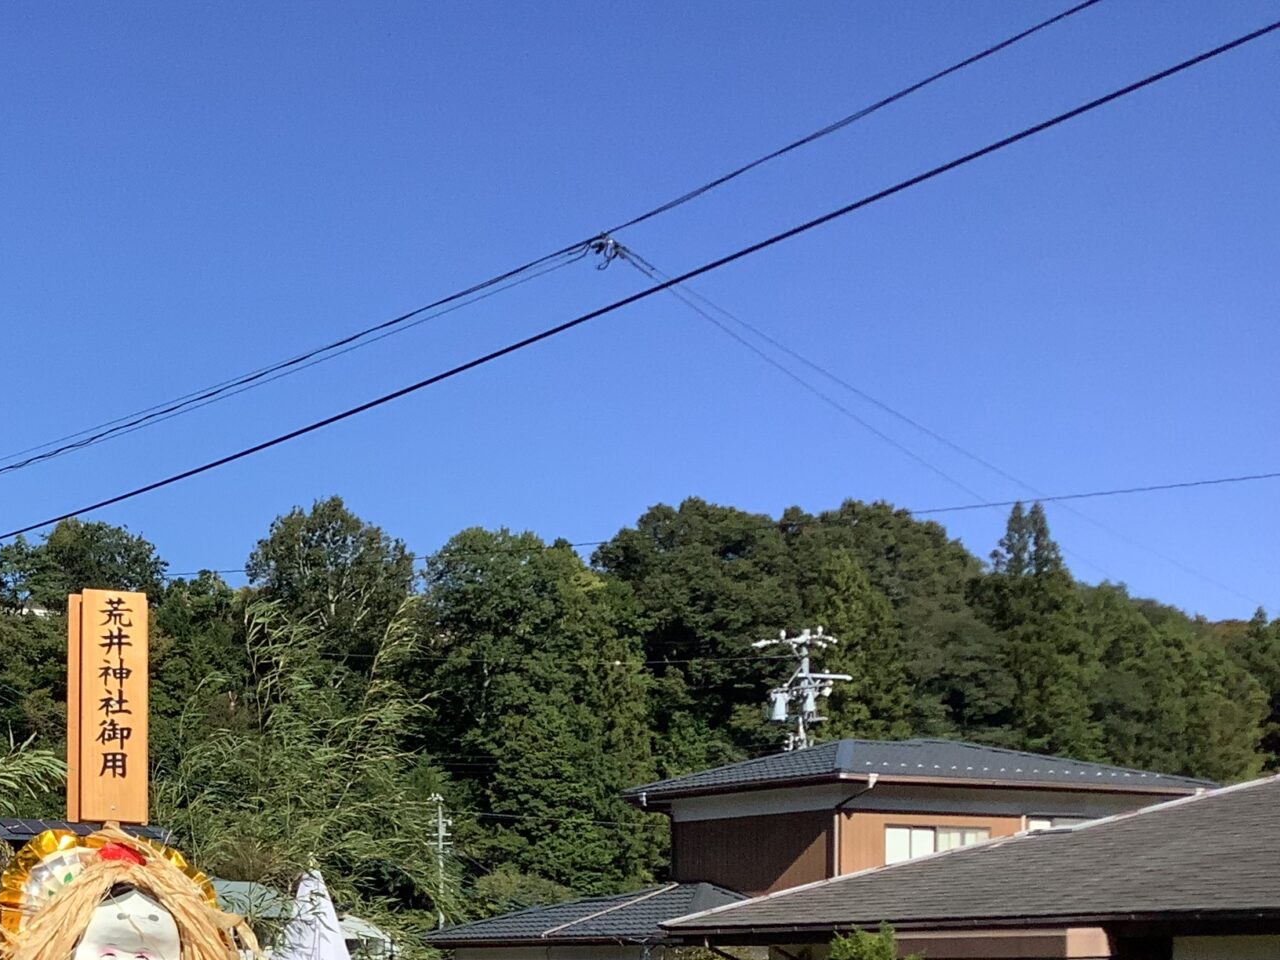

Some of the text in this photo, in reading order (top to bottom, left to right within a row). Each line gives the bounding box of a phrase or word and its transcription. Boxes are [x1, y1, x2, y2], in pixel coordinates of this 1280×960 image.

[95, 597, 133, 778] 荒井神社御用
